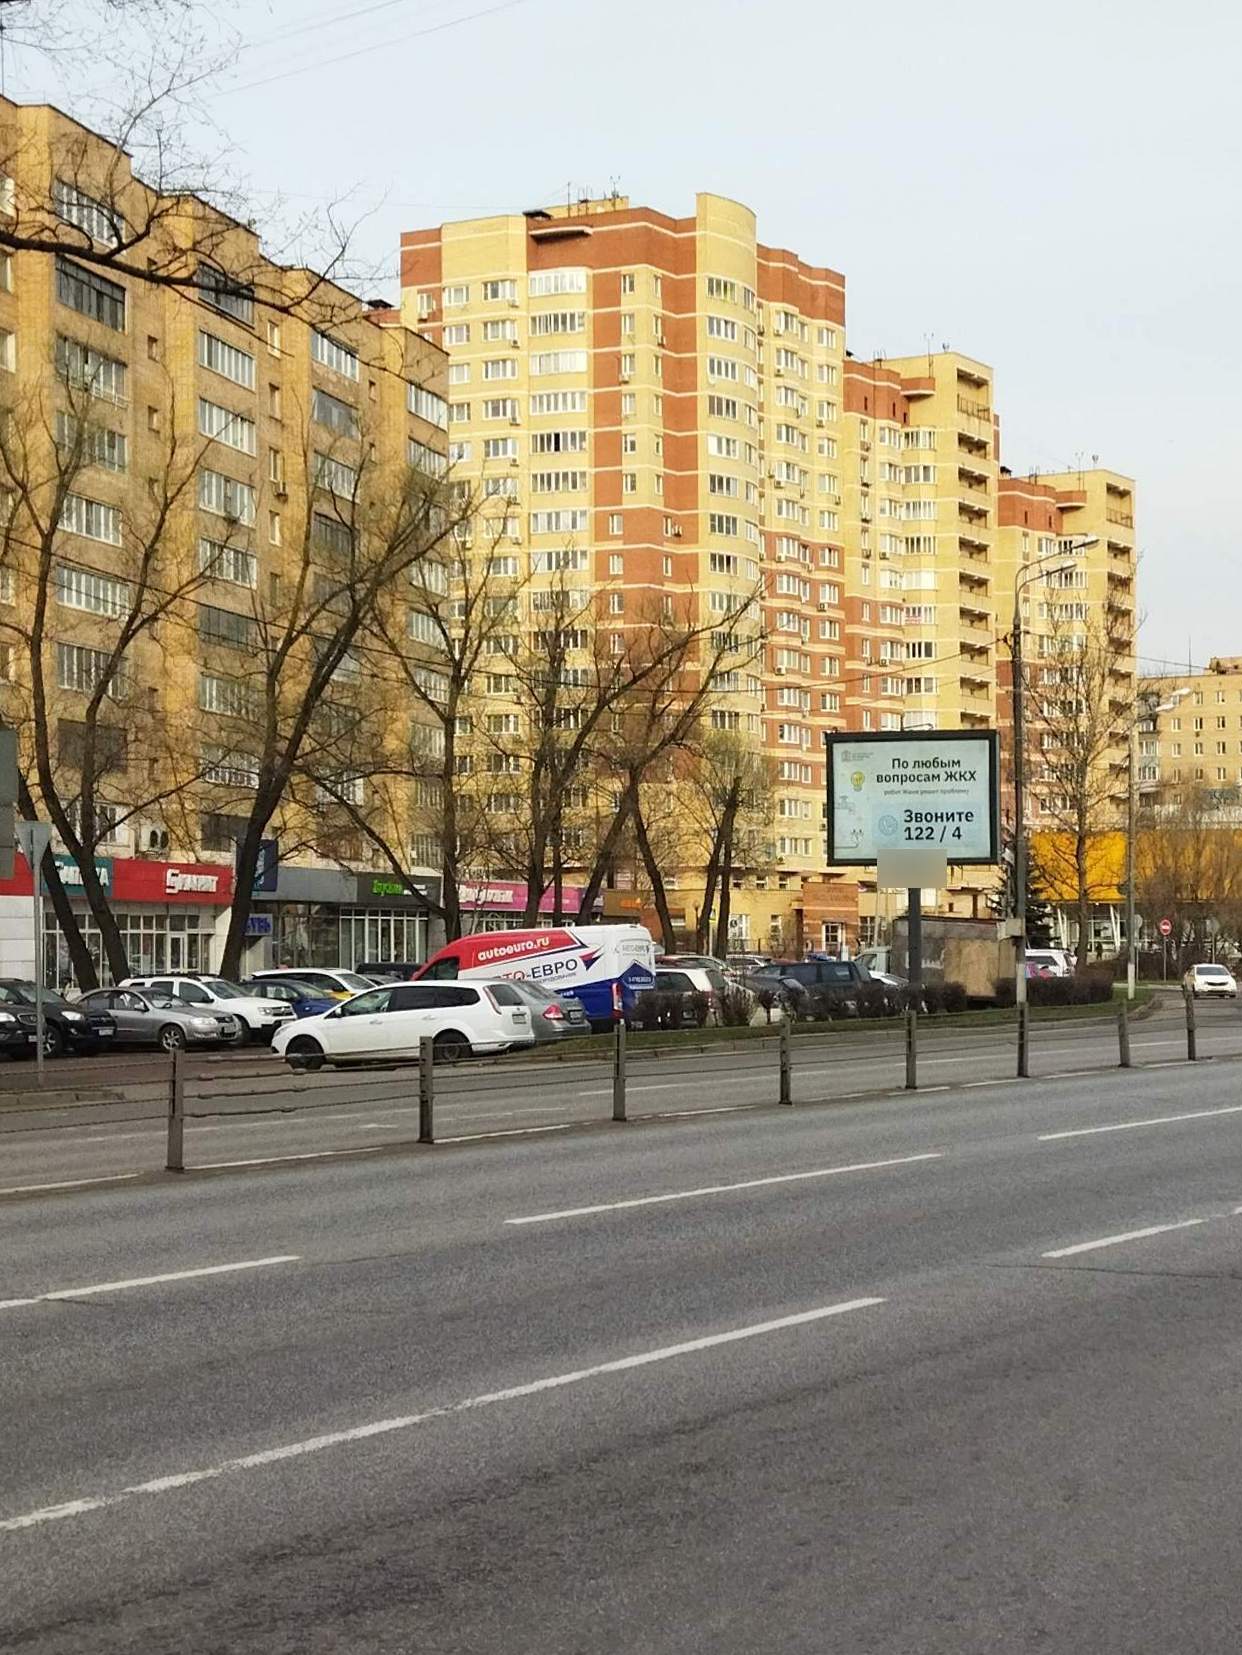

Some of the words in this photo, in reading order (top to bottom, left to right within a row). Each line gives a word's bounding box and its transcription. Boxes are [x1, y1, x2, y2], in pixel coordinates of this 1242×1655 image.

[891, 758, 909, 769] По
[911, 757, 961, 769] любым
[876, 773, 941, 785] вопросам
[944, 770, 977, 782] ЖКХ
[903, 809, 974, 823] Звоните
[904, 826, 935, 841] 122
[951, 826, 962, 840] 4
[477, 936, 550, 962] autoeuro.ru
